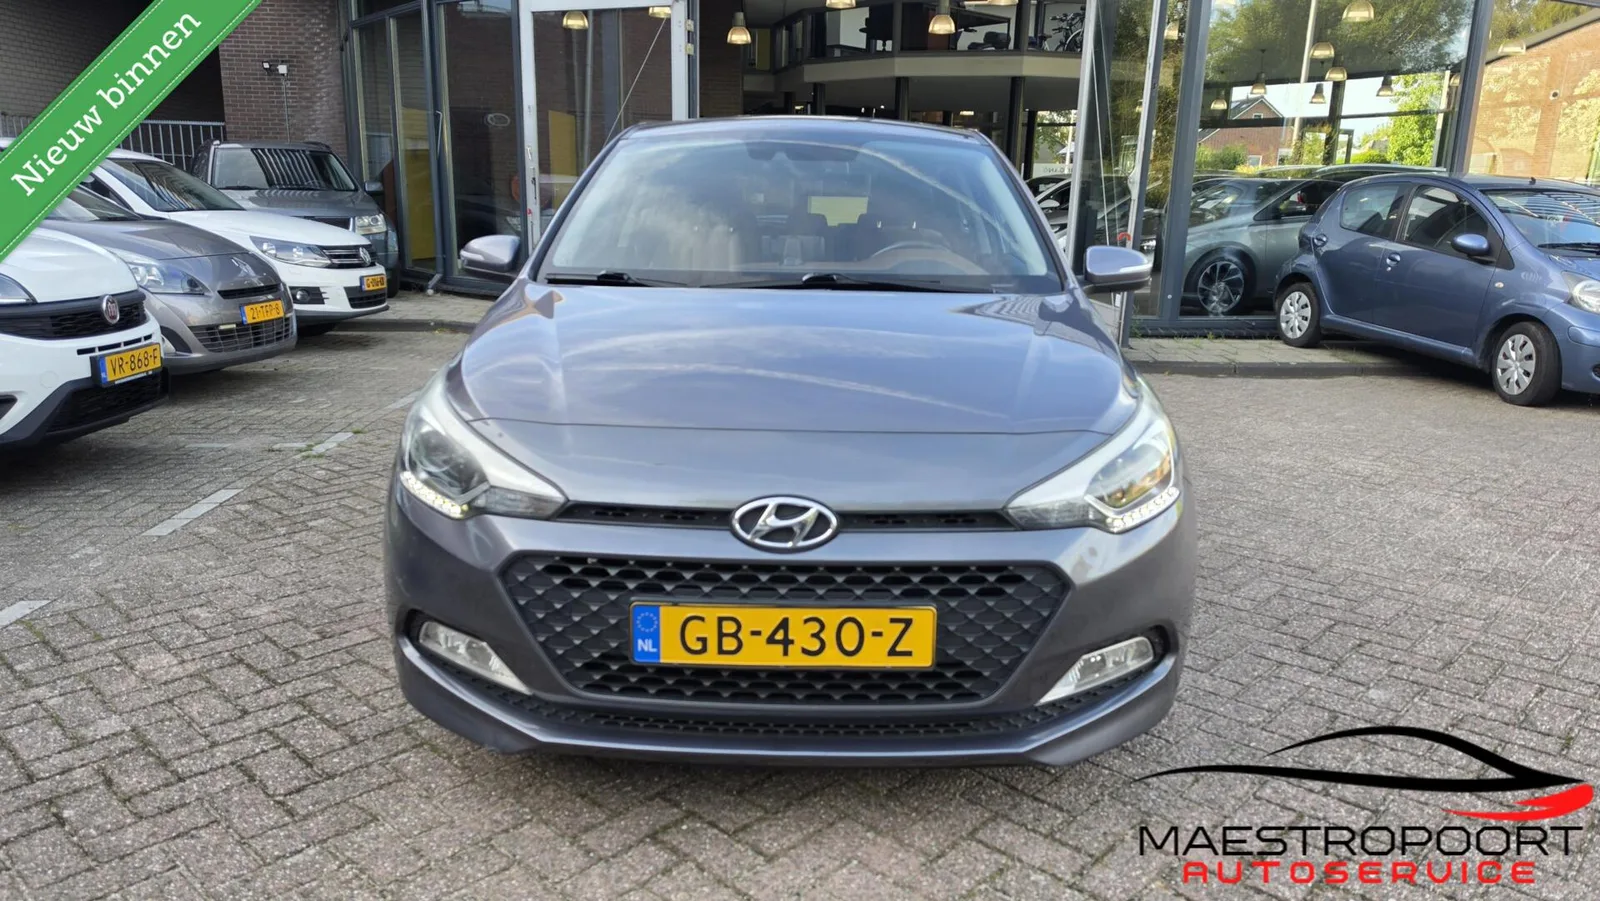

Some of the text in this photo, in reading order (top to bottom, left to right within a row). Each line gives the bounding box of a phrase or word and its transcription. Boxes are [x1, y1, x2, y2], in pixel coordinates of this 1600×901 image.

[110, 348, 158, 376] VR-868-F
[637, 638, 658, 652] NL
[679, 615, 914, 657] GB-430-Z
